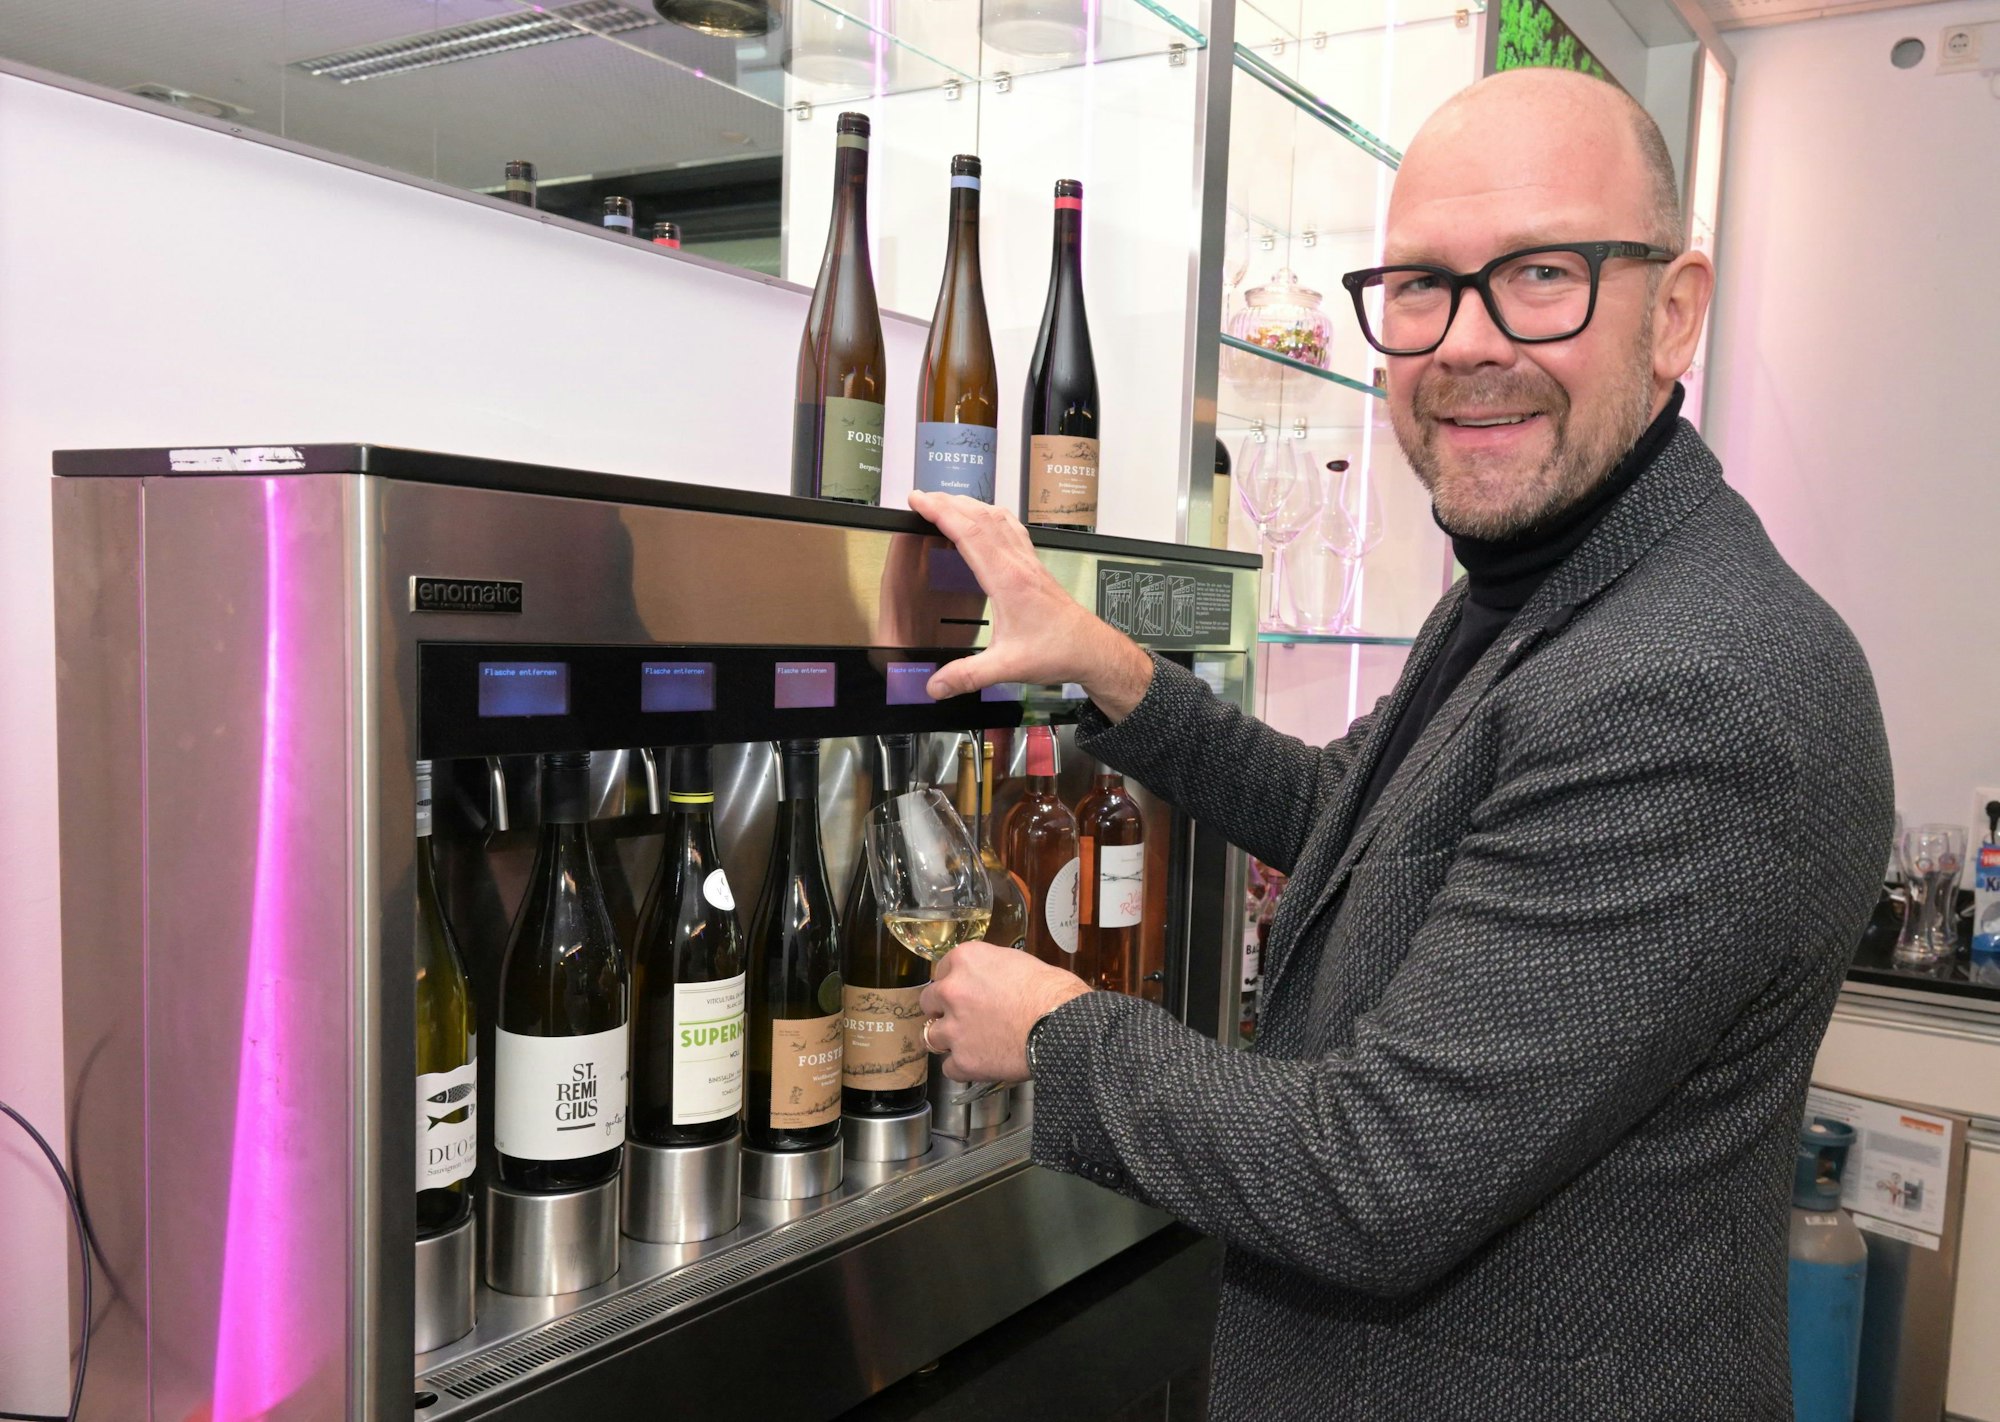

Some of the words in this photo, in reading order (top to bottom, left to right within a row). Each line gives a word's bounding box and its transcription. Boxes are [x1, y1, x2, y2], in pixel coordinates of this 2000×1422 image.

[928, 451, 984, 465] FORSTER
[1046, 463, 1096, 477] FORSTER
[419, 582, 520, 604] enomatic
[484, 668, 516, 677] Flasche
[518, 668, 557, 677] entfernen
[644, 667, 671, 676] Flasche
[673, 667, 705, 676] entfernen
[777, 667, 799, 675] Flasche
[800, 667, 828, 675] entfernen
[572, 1062, 597, 1082] ST.
[555, 1098, 598, 1122] GIUS
[427, 1138, 468, 1166] DUO
[426, 1161, 462, 1176] Sauvignon
